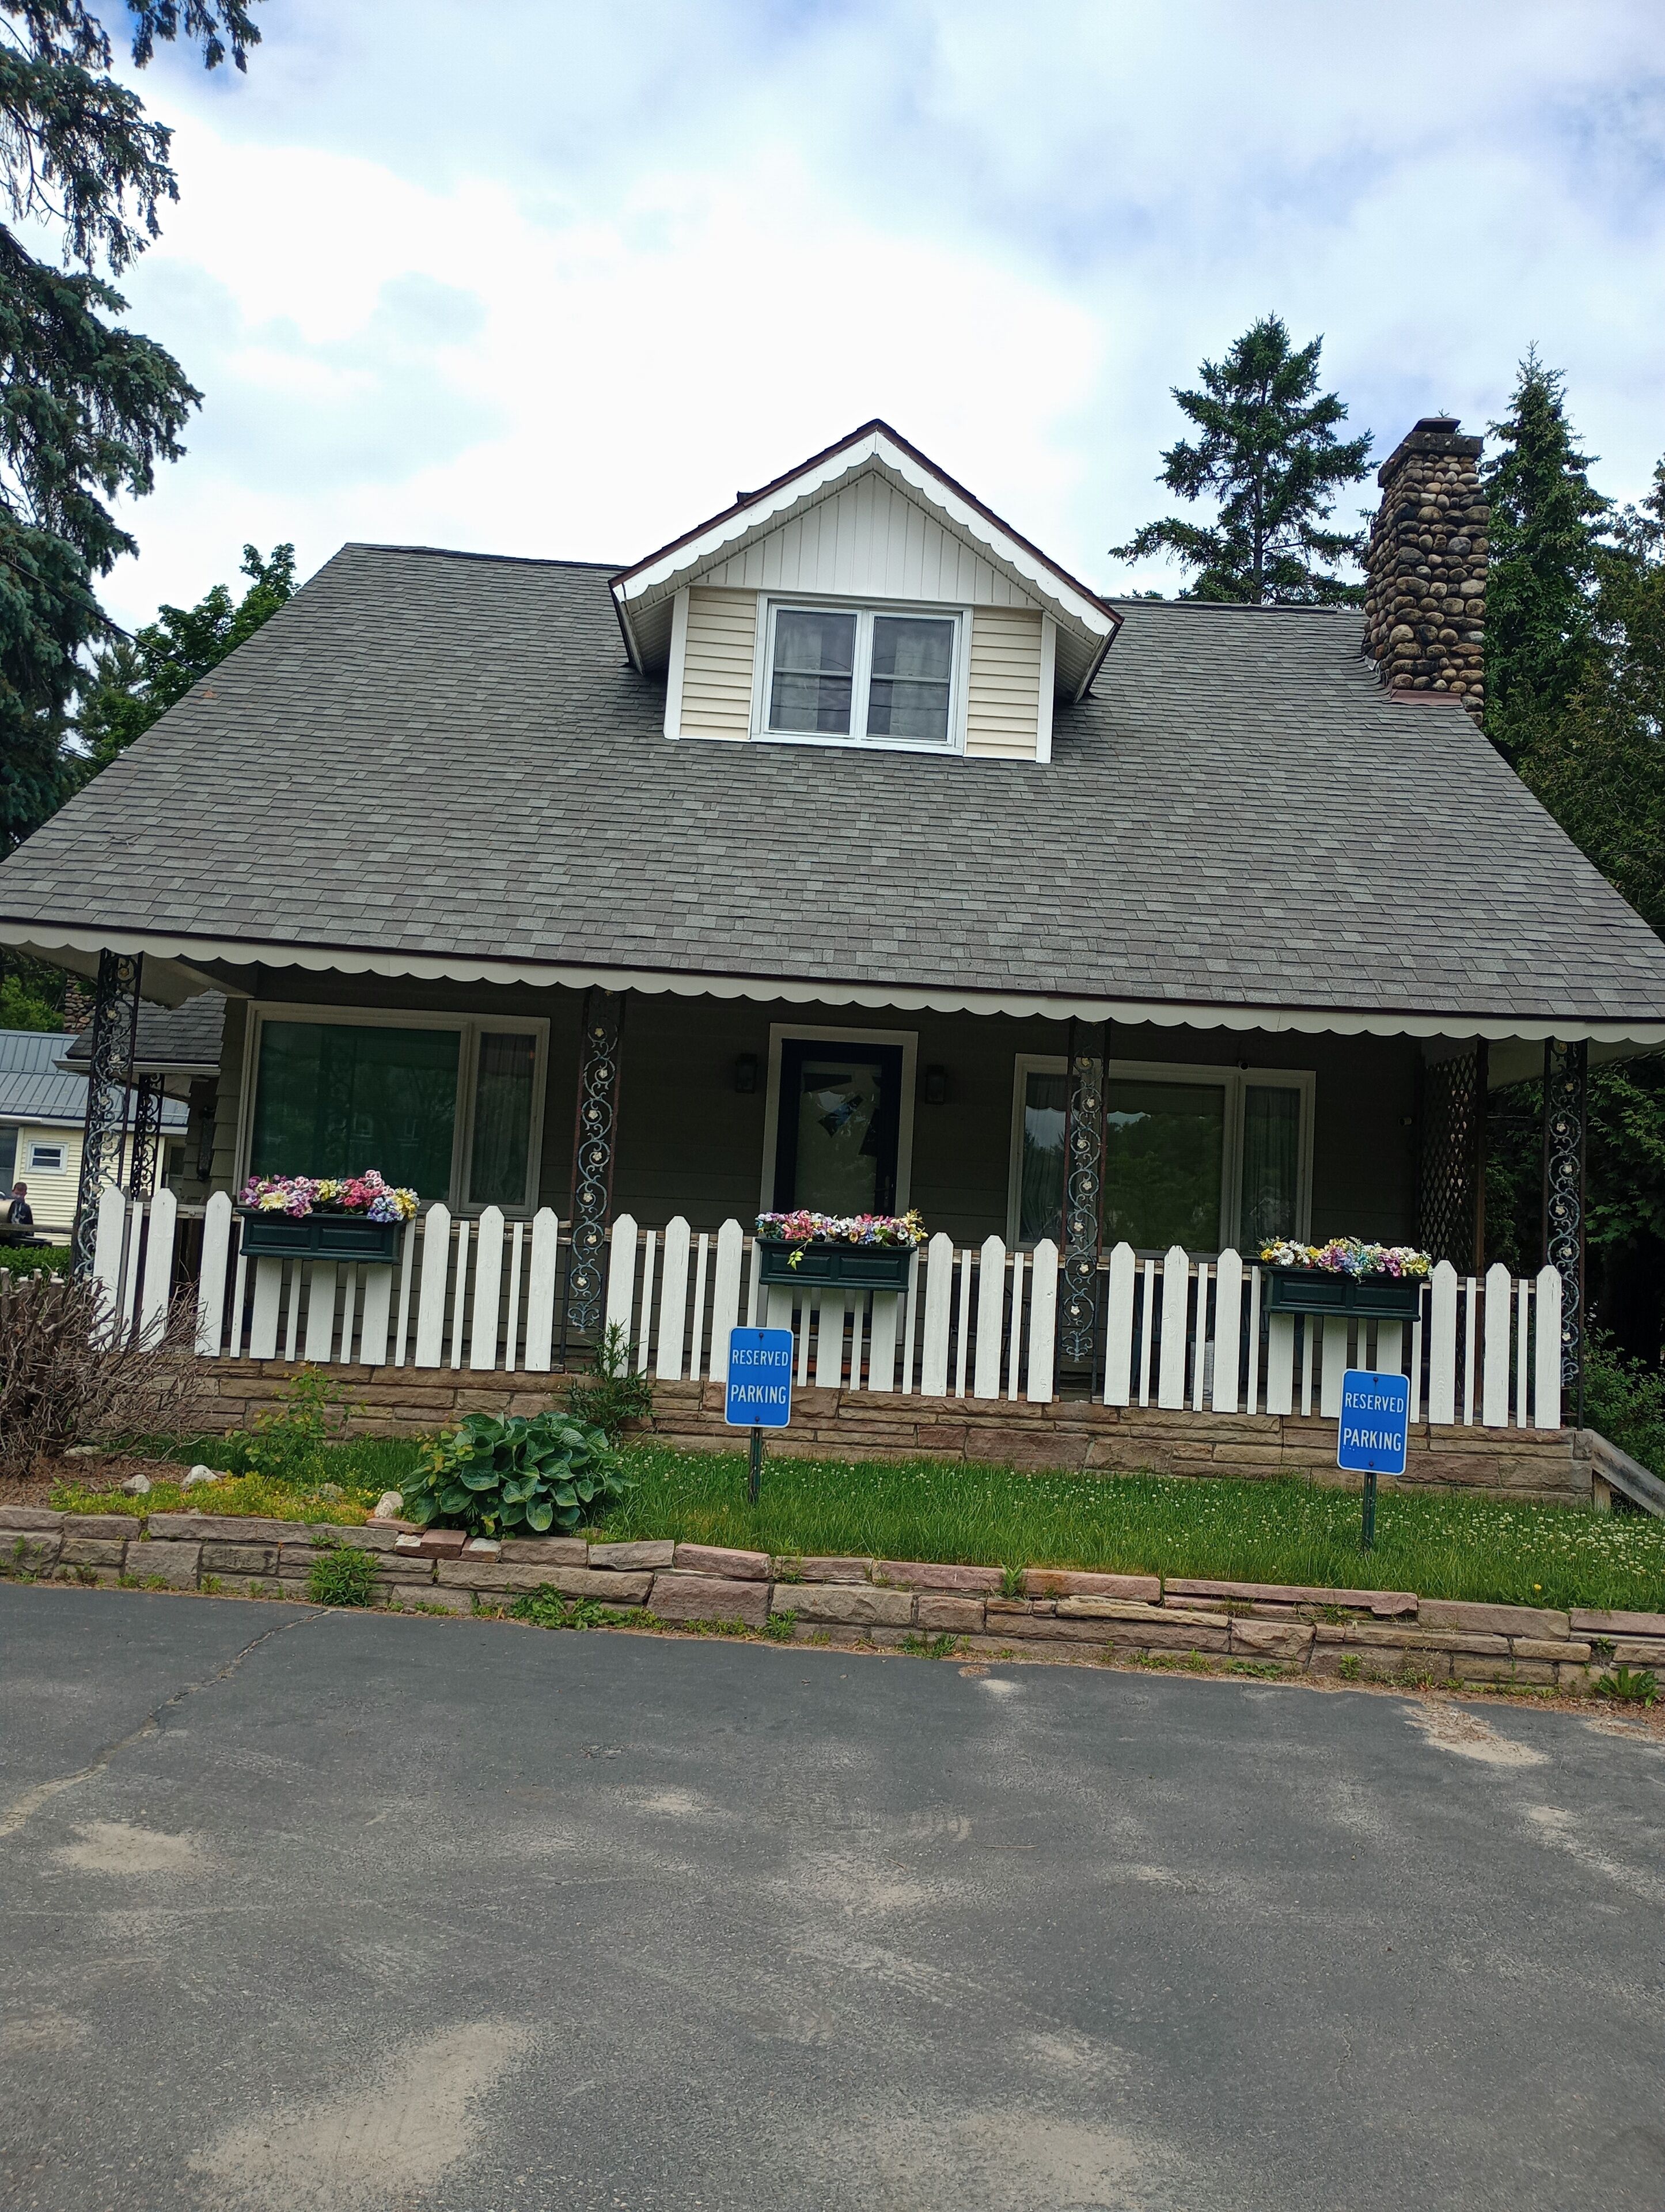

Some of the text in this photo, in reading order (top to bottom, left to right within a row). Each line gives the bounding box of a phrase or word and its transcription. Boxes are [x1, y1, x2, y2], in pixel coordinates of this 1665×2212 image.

[732, 1349, 788, 1366] RESERVED
[730, 1384, 787, 1404] PARKING
[1345, 1392, 1404, 1413] RESERVED
[1343, 1427, 1402, 1452] PARKING
